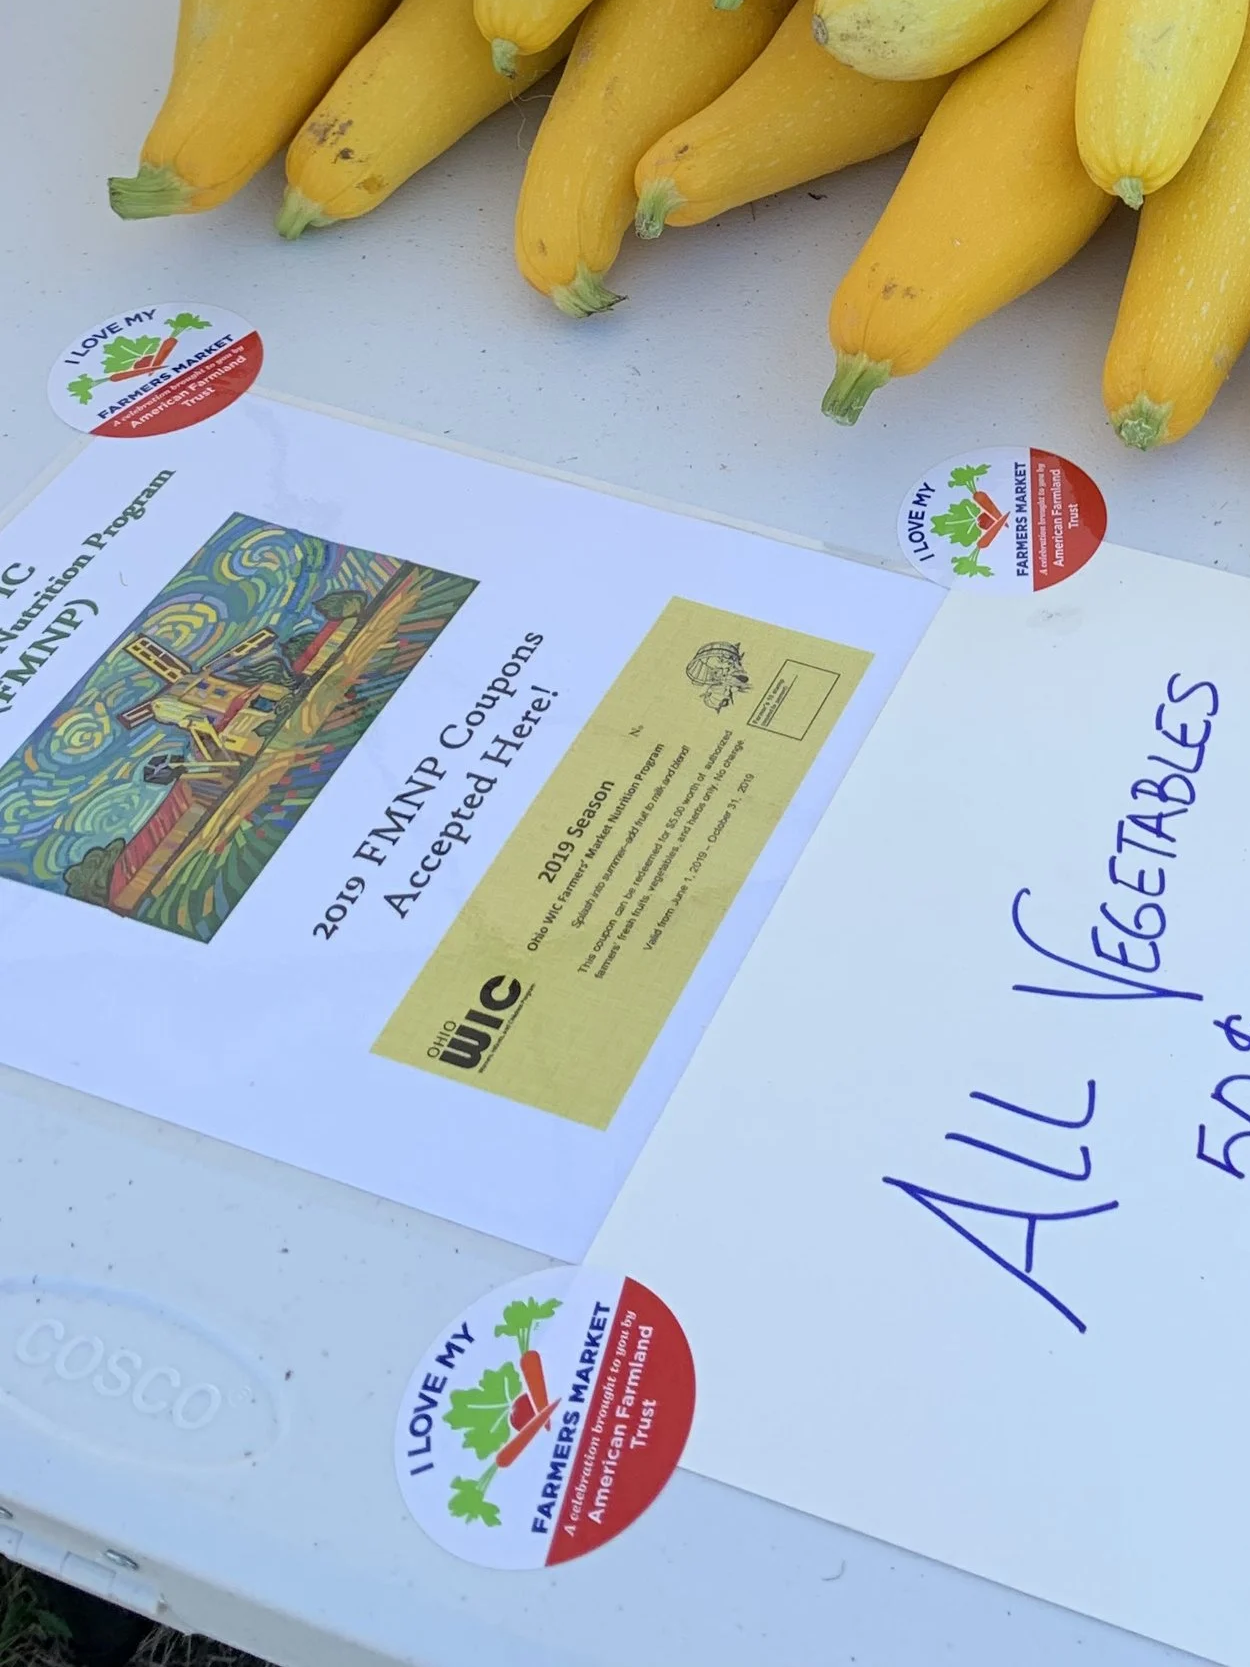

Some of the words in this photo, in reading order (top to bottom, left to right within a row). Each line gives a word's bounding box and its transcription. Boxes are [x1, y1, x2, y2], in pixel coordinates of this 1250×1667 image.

[71, 321, 123, 357] LOVE
[124, 308, 157, 327] MY
[97, 372, 172, 420] FARMERS
[172, 333, 234, 374] MARKET
[121, 389, 171, 421] celebration
[170, 368, 206, 397] brought
[215, 352, 233, 365] you
[232, 345, 245, 356] by
[130, 389, 190, 429] American
[190, 356, 247, 394] Farmland
[181, 387, 216, 409] Trust
[1014, 462, 1027, 513] MARKET
[1036, 463, 1047, 473] by
[1038, 474, 1048, 487] you
[1049, 468, 1064, 516] Farmland
[80, 469, 177, 551] Program
[912, 482, 936, 508] MY
[1036, 496, 1048, 528] brought
[1067, 503, 1079, 530] Trust
[907, 509, 930, 556] LOVE
[919, 552, 935, 562] I
[1016, 515, 1029, 577] FARMERS
[1037, 528, 1048, 568] celebration
[1051, 515, 1065, 568] American
[312, 875, 367, 941] 2019
[352, 756, 447, 867] FMNP
[438, 632, 544, 750] Coupons
[383, 772, 498, 919] Accepted
[480, 685, 559, 768] Here!
[526, 926, 548, 951] Ohio
[542, 902, 563, 924] WIC
[557, 859, 588, 902] Farmers'
[584, 824, 612, 859] Market
[607, 782, 639, 823] Nutrition
[633, 743, 664, 781] Program
[537, 841, 574, 883] 2019
[566, 780, 614, 838] Season
[570, 898, 595, 928] Splash
[590, 881, 605, 898] into
[633, 810, 649, 827] fruit
[644, 801, 654, 811] to
[651, 785, 666, 802] milk
[661, 767, 675, 786] and
[576, 953, 596, 972] This
[592, 919, 617, 952] coupon
[614, 900, 628, 916] can
[622, 887, 636, 899] be
[632, 842, 662, 886] redeemed
[657, 829, 670, 842] for
[681, 782, 700, 804] worth
[696, 772, 706, 782] of
[704, 729, 732, 769] authorized
[616, 917, 636, 940] fresh
[677, 825, 691, 842] and
[686, 802, 706, 825] herbs
[713, 768, 726, 781] No
[642, 928, 662, 950] Valid
[656, 907, 675, 927] from
[671, 884, 688, 906] June
[689, 850, 707, 873] 2019
[707, 810, 731, 843] October
[736, 773, 754, 793] 2019
[439, 975, 521, 1068] WIC
[882, 1078, 1120, 1334] ALL
[1011, 672, 1221, 1002] VEGETABLES
[426, 1020, 456, 1058] OHIO
[615, 1330, 631, 1358] you
[623, 1309, 638, 1328] by
[434, 1321, 475, 1370] MY
[610, 1360, 621, 1375] to
[407, 1372, 448, 1457] LOVE
[530, 1410, 581, 1534] FARMERS
[568, 1301, 611, 1403] MARKET
[587, 1425, 627, 1525] American
[615, 1325, 655, 1421] Farmland
[591, 1378, 617, 1440] brought
[629, 1399, 657, 1450] Trust
[409, 1462, 434, 1476] I
[570, 1441, 600, 1523] celebration
[563, 1523, 575, 1537] A
